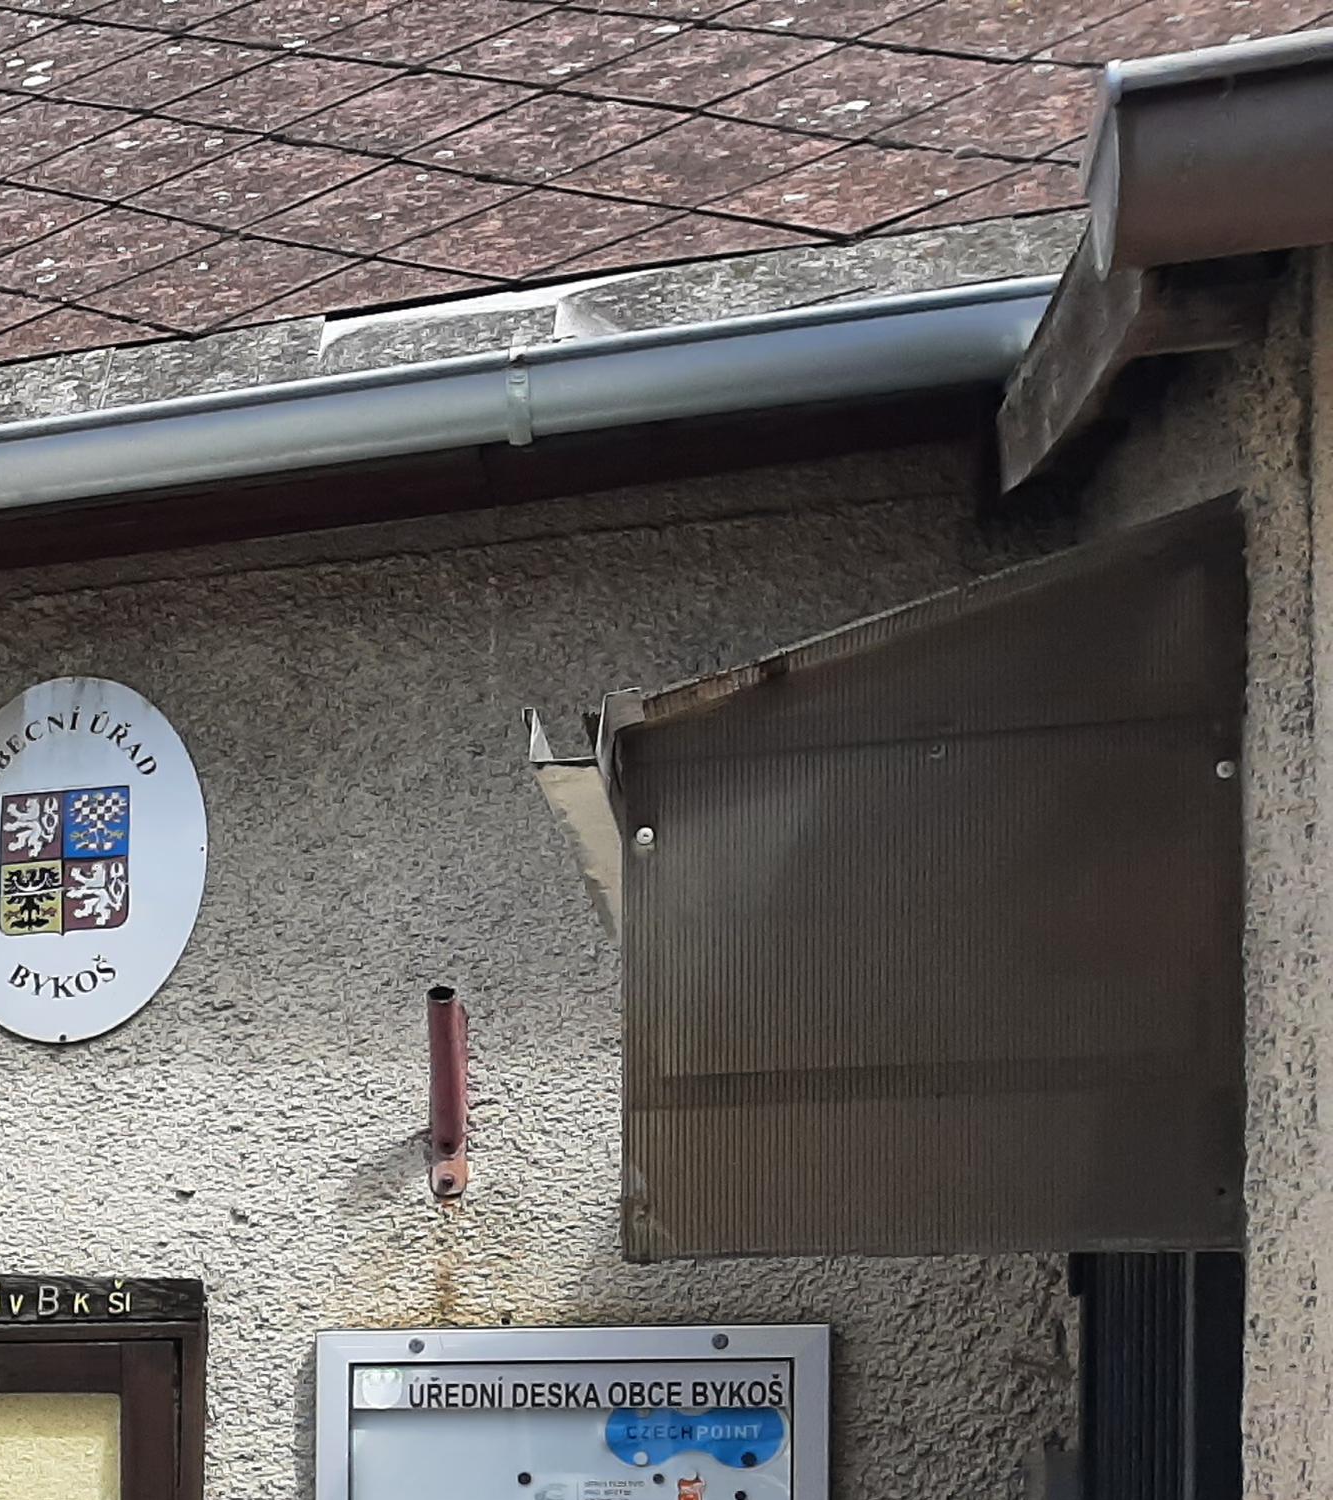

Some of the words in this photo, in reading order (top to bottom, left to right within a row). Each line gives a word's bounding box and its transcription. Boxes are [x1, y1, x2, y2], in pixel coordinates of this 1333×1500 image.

[89, 711, 158, 777] ÚŘAD
[7, 954, 117, 999] BYKOŠ
[408, 1376, 504, 1409] ÚŘEDNÍ
[512, 1382, 601, 1409] DESKA
[607, 1380, 682, 1408] OBCE
[691, 1373, 784, 1407] BYKOŠ
